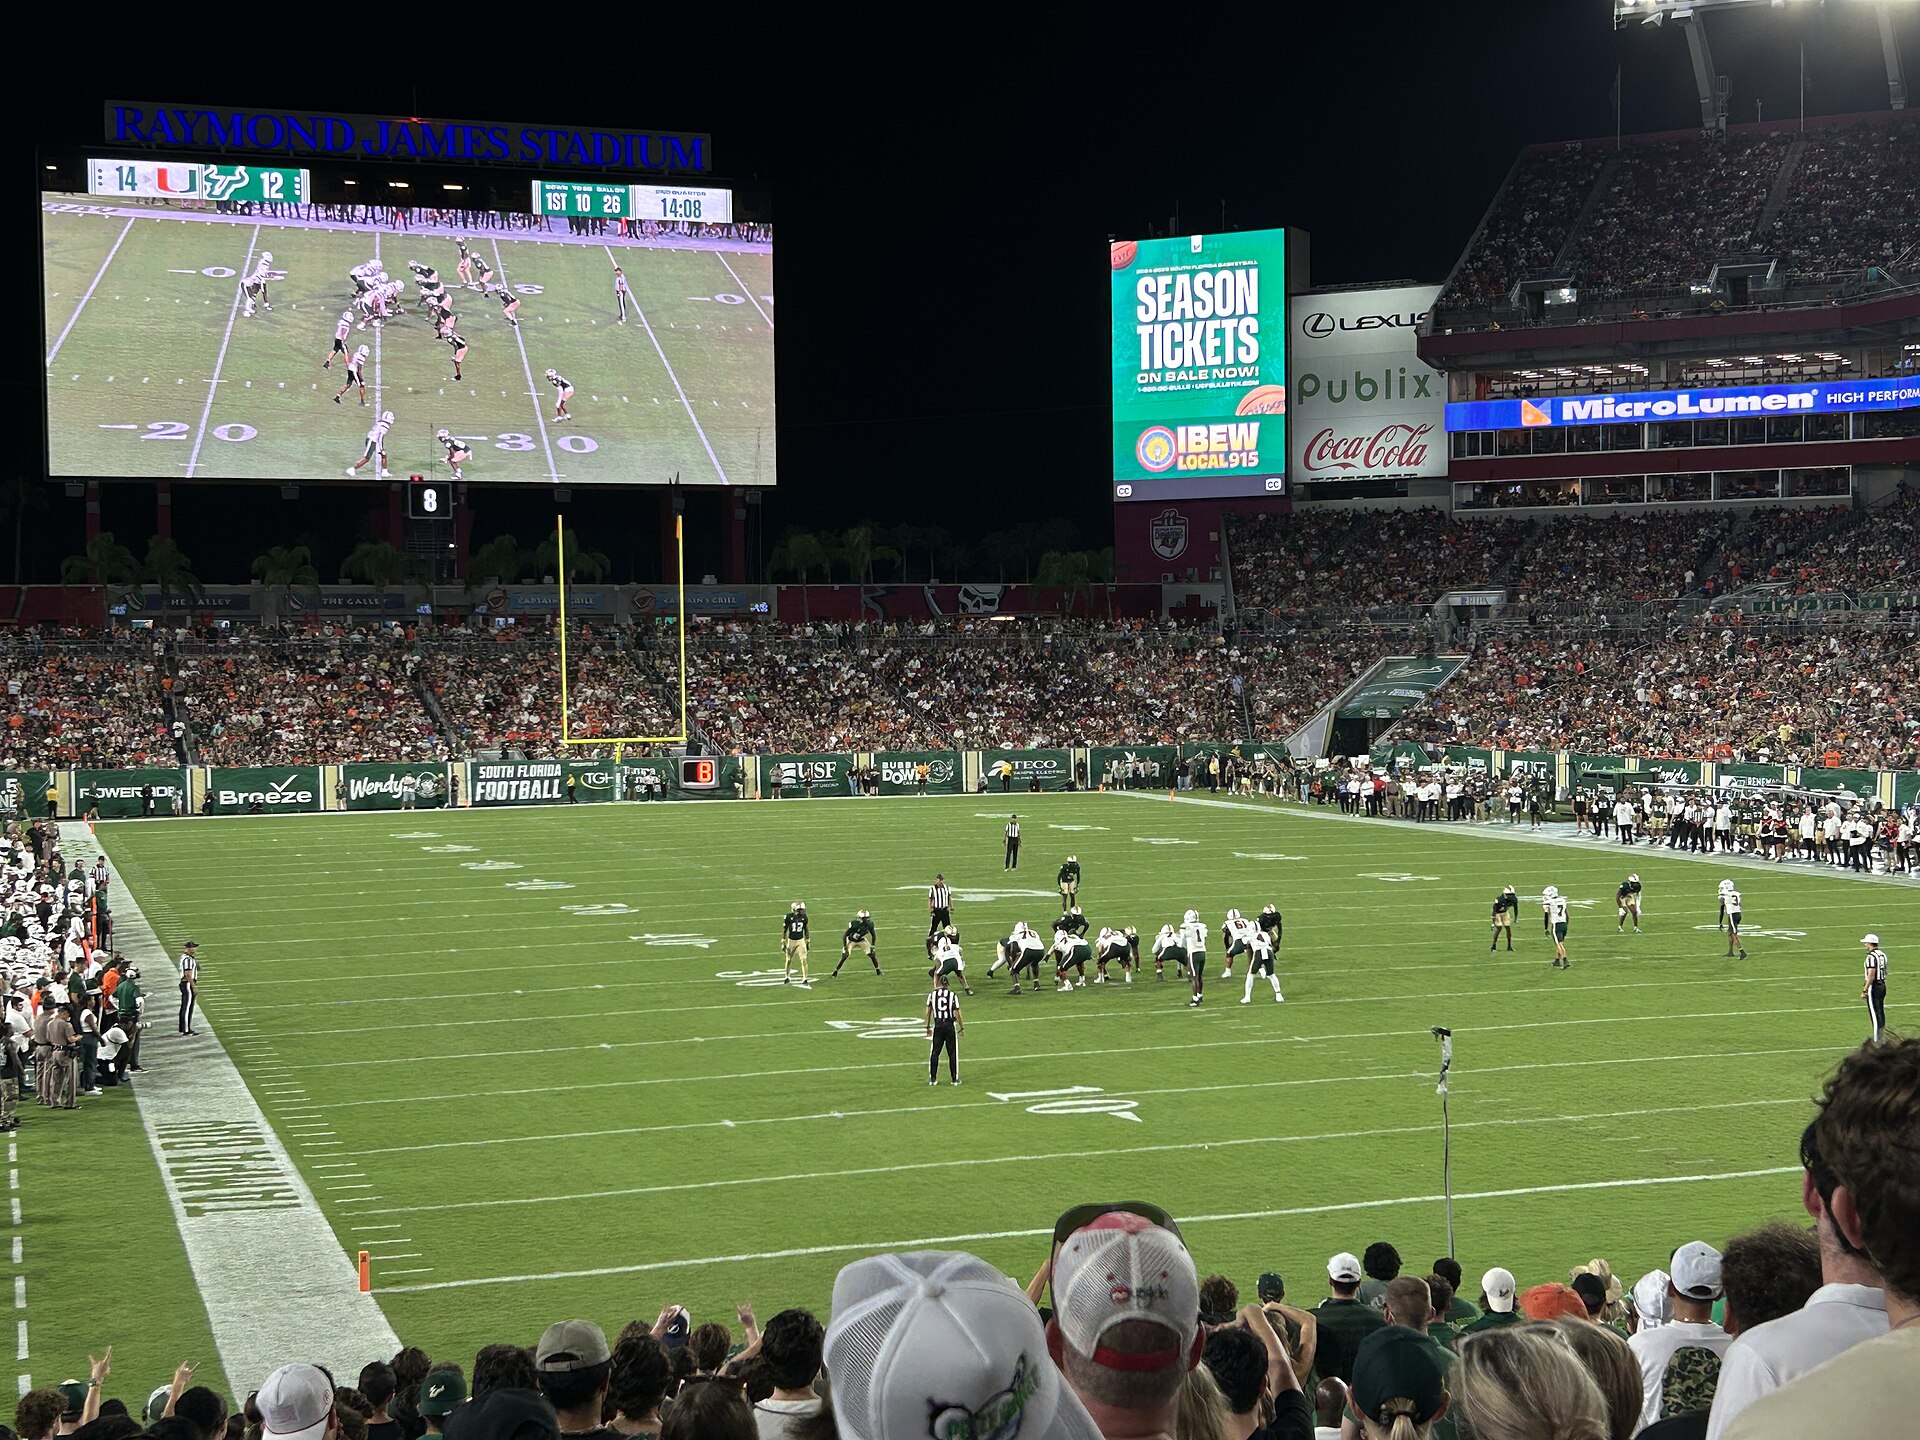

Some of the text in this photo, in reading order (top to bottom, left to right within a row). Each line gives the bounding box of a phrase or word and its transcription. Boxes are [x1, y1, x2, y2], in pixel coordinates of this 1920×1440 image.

[112, 106, 706, 171] RAYMOND JAMES STADIUM
[114, 166, 284, 200] 14 U 12
[545, 192, 702, 219] 1ST 10 26 14:08
[1136, 268, 1259, 323] SEASON
[1136, 317, 1259, 370] TICKETS
[1137, 366, 1259, 384] ON SALE NOW!
[1297, 367, 1431, 405] Publix
[1561, 392, 1814, 421] MicroLumen
[1826, 392, 1864, 404] HIGH
[1177, 422, 1260, 453] IBEW
[1303, 423, 1435, 472] Coca-Cola
[1177, 452, 1259, 470] LOCAL 915
[1118, 486, 1131, 496] CC
[1267, 480, 1280, 489] CC
[423, 488, 437, 512] 8
[478, 765, 515, 779] SOUTH
[520, 764, 562, 778] FLORIDA
[796, 761, 837, 779] USF
[882, 761, 918, 769] BUBBL
[1011, 760, 1058, 769] TECO
[219, 789, 313, 805] Breeze
[350, 776, 405, 801] Wendy
[475, 779, 563, 801] FOOTBALL
[1731, 894, 1739, 907] 3
[1557, 904, 1564, 917] 7
[1195, 928, 1202, 943] 1
[1256, 933, 1265, 943] 4
[937, 997, 948, 1011] C
